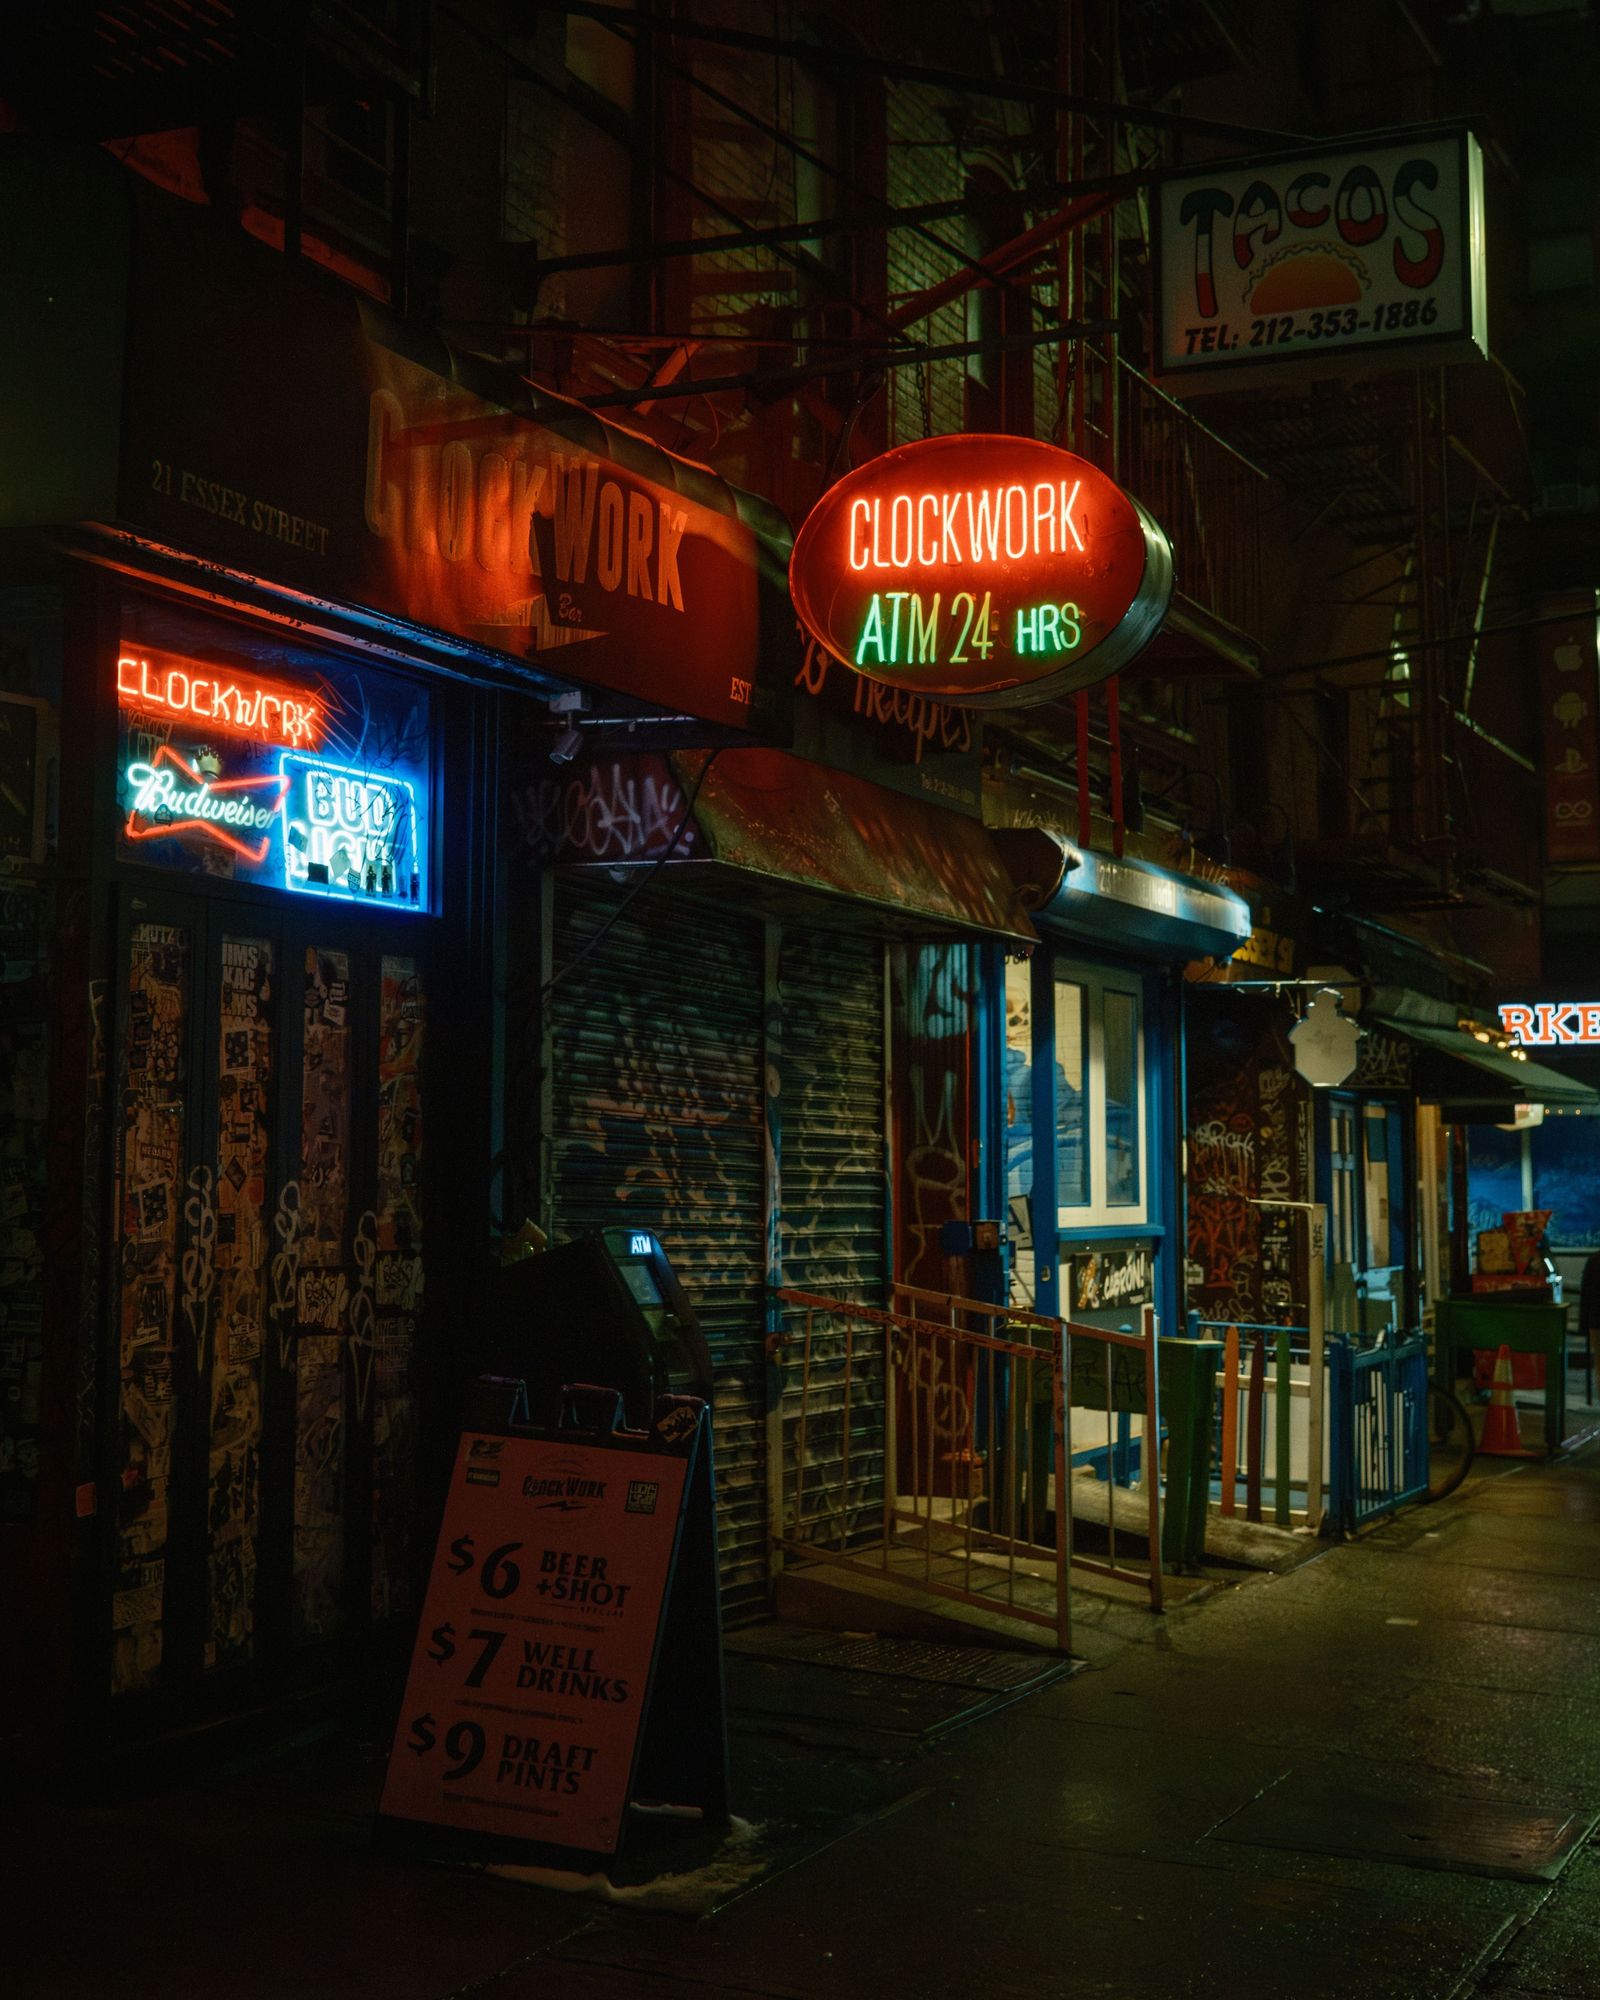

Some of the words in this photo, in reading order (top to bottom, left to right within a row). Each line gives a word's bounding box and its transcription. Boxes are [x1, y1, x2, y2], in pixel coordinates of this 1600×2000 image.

[1180, 159, 1444, 318] TACOS
[1185, 324, 1239, 355] TEL:
[1250, 297, 1438, 347] 212-353-1886
[151, 459, 173, 496] 21
[180, 469, 249, 528] ESSEX
[251, 500, 330, 557] STREET
[849, 480, 1085, 571] CLOCKWORK
[856, 592, 942, 665] ATM
[949, 591, 994, 664] 24
[1016, 601, 1080, 655] HRS
[127, 762, 276, 829] Budweiser
[305, 769, 395, 836] BUD
[631, 1235, 652, 1255] ATM
[447, 1534, 523, 1599] $6
[536, 1576, 631, 1609] +SHOT
[539, 1550, 608, 1581] BEER
[427, 1622, 507, 1688] $7
[516, 1665, 629, 1703] DRINKS
[523, 1640, 597, 1673] WELL
[407, 1713, 487, 1782] $9
[496, 1760, 581, 1795] PINTS
[503, 1734, 598, 1771] DRAFT
